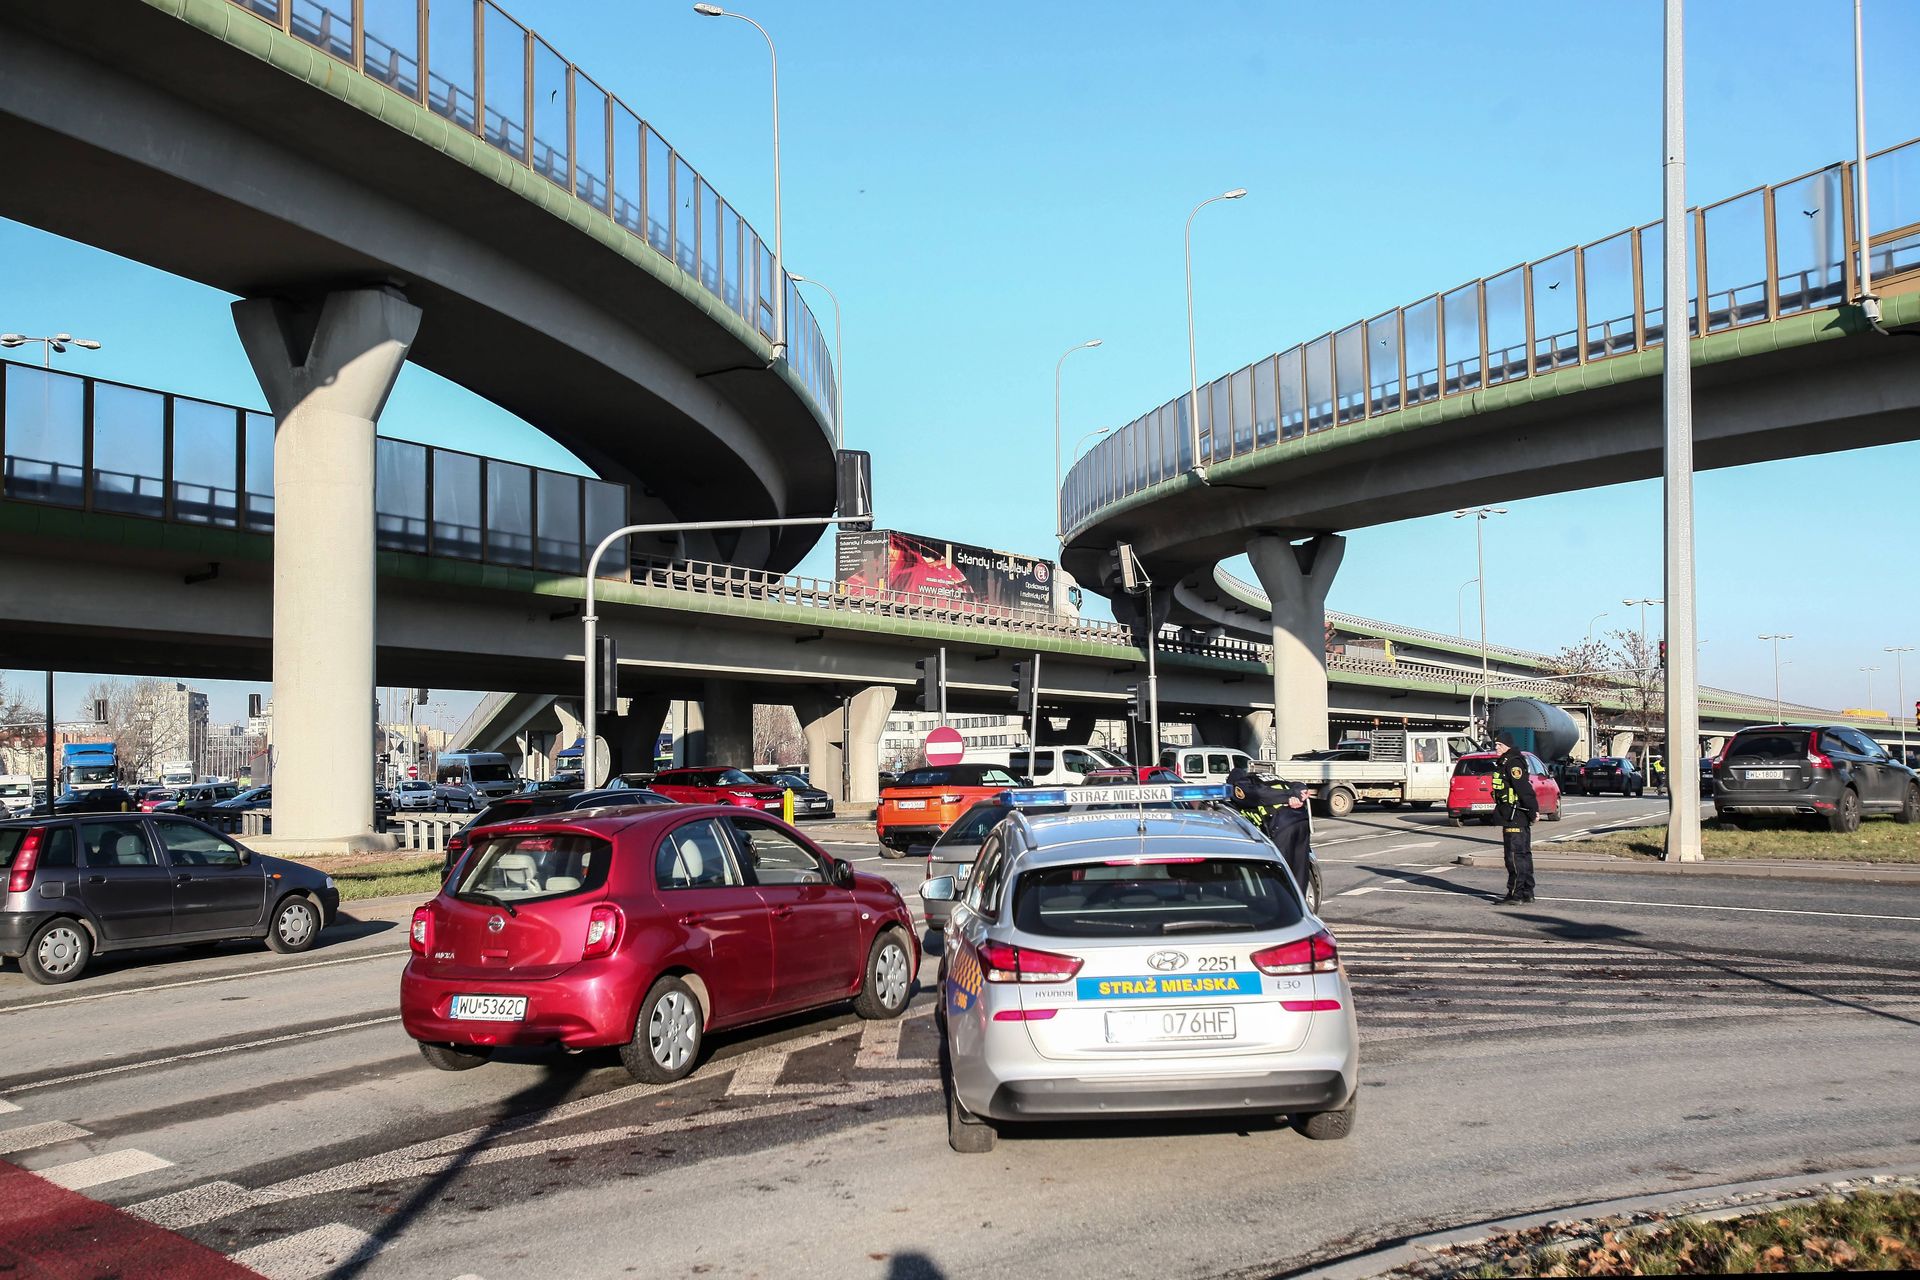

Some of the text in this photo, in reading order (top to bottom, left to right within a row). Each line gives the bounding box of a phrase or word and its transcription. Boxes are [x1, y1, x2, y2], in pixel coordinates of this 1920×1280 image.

[957, 552, 991, 570] Standy
[1113, 788, 1168, 801] MIEJSKA
[1198, 955, 1237, 972] 2251
[1099, 977, 1240, 995] STRAŻ MIEJSKA
